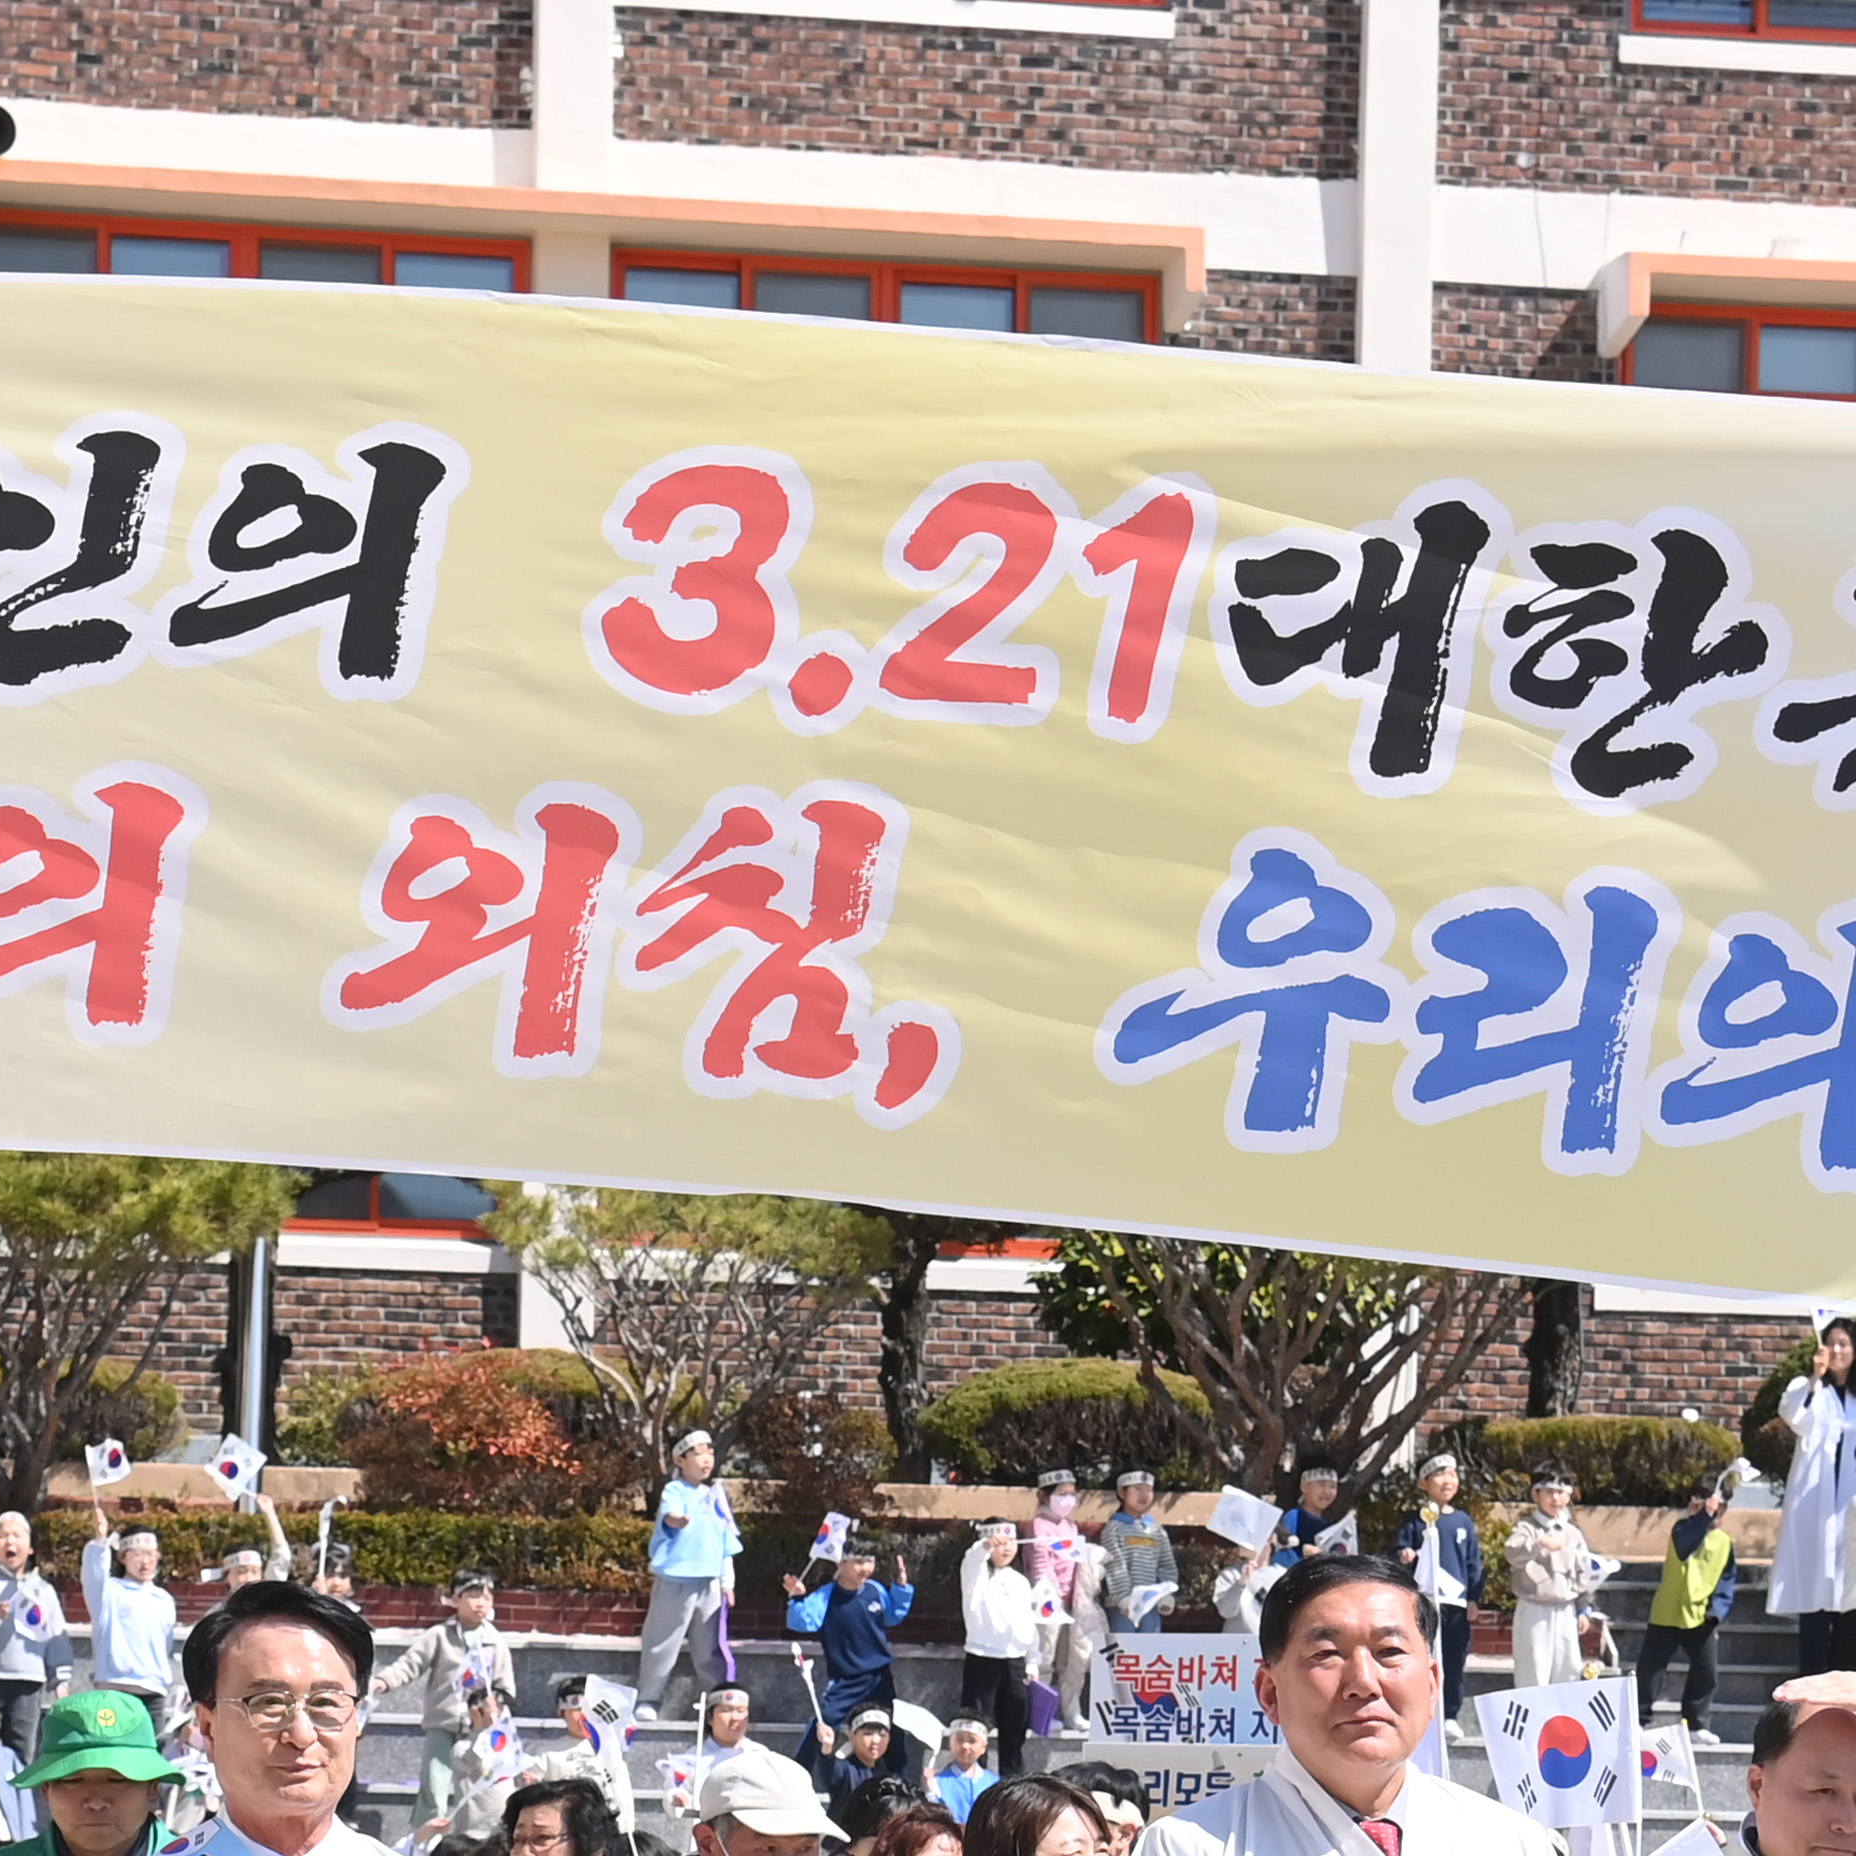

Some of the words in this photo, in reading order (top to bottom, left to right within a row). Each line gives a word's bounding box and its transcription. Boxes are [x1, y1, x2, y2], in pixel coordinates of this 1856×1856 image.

[601, 464, 1194, 724] 3.21
[341, 800, 939, 1109] 외침,
[1110, 1706, 1236, 1744] 목숨바쳐
[1112, 1654, 1238, 1692] 목숨바쳐
